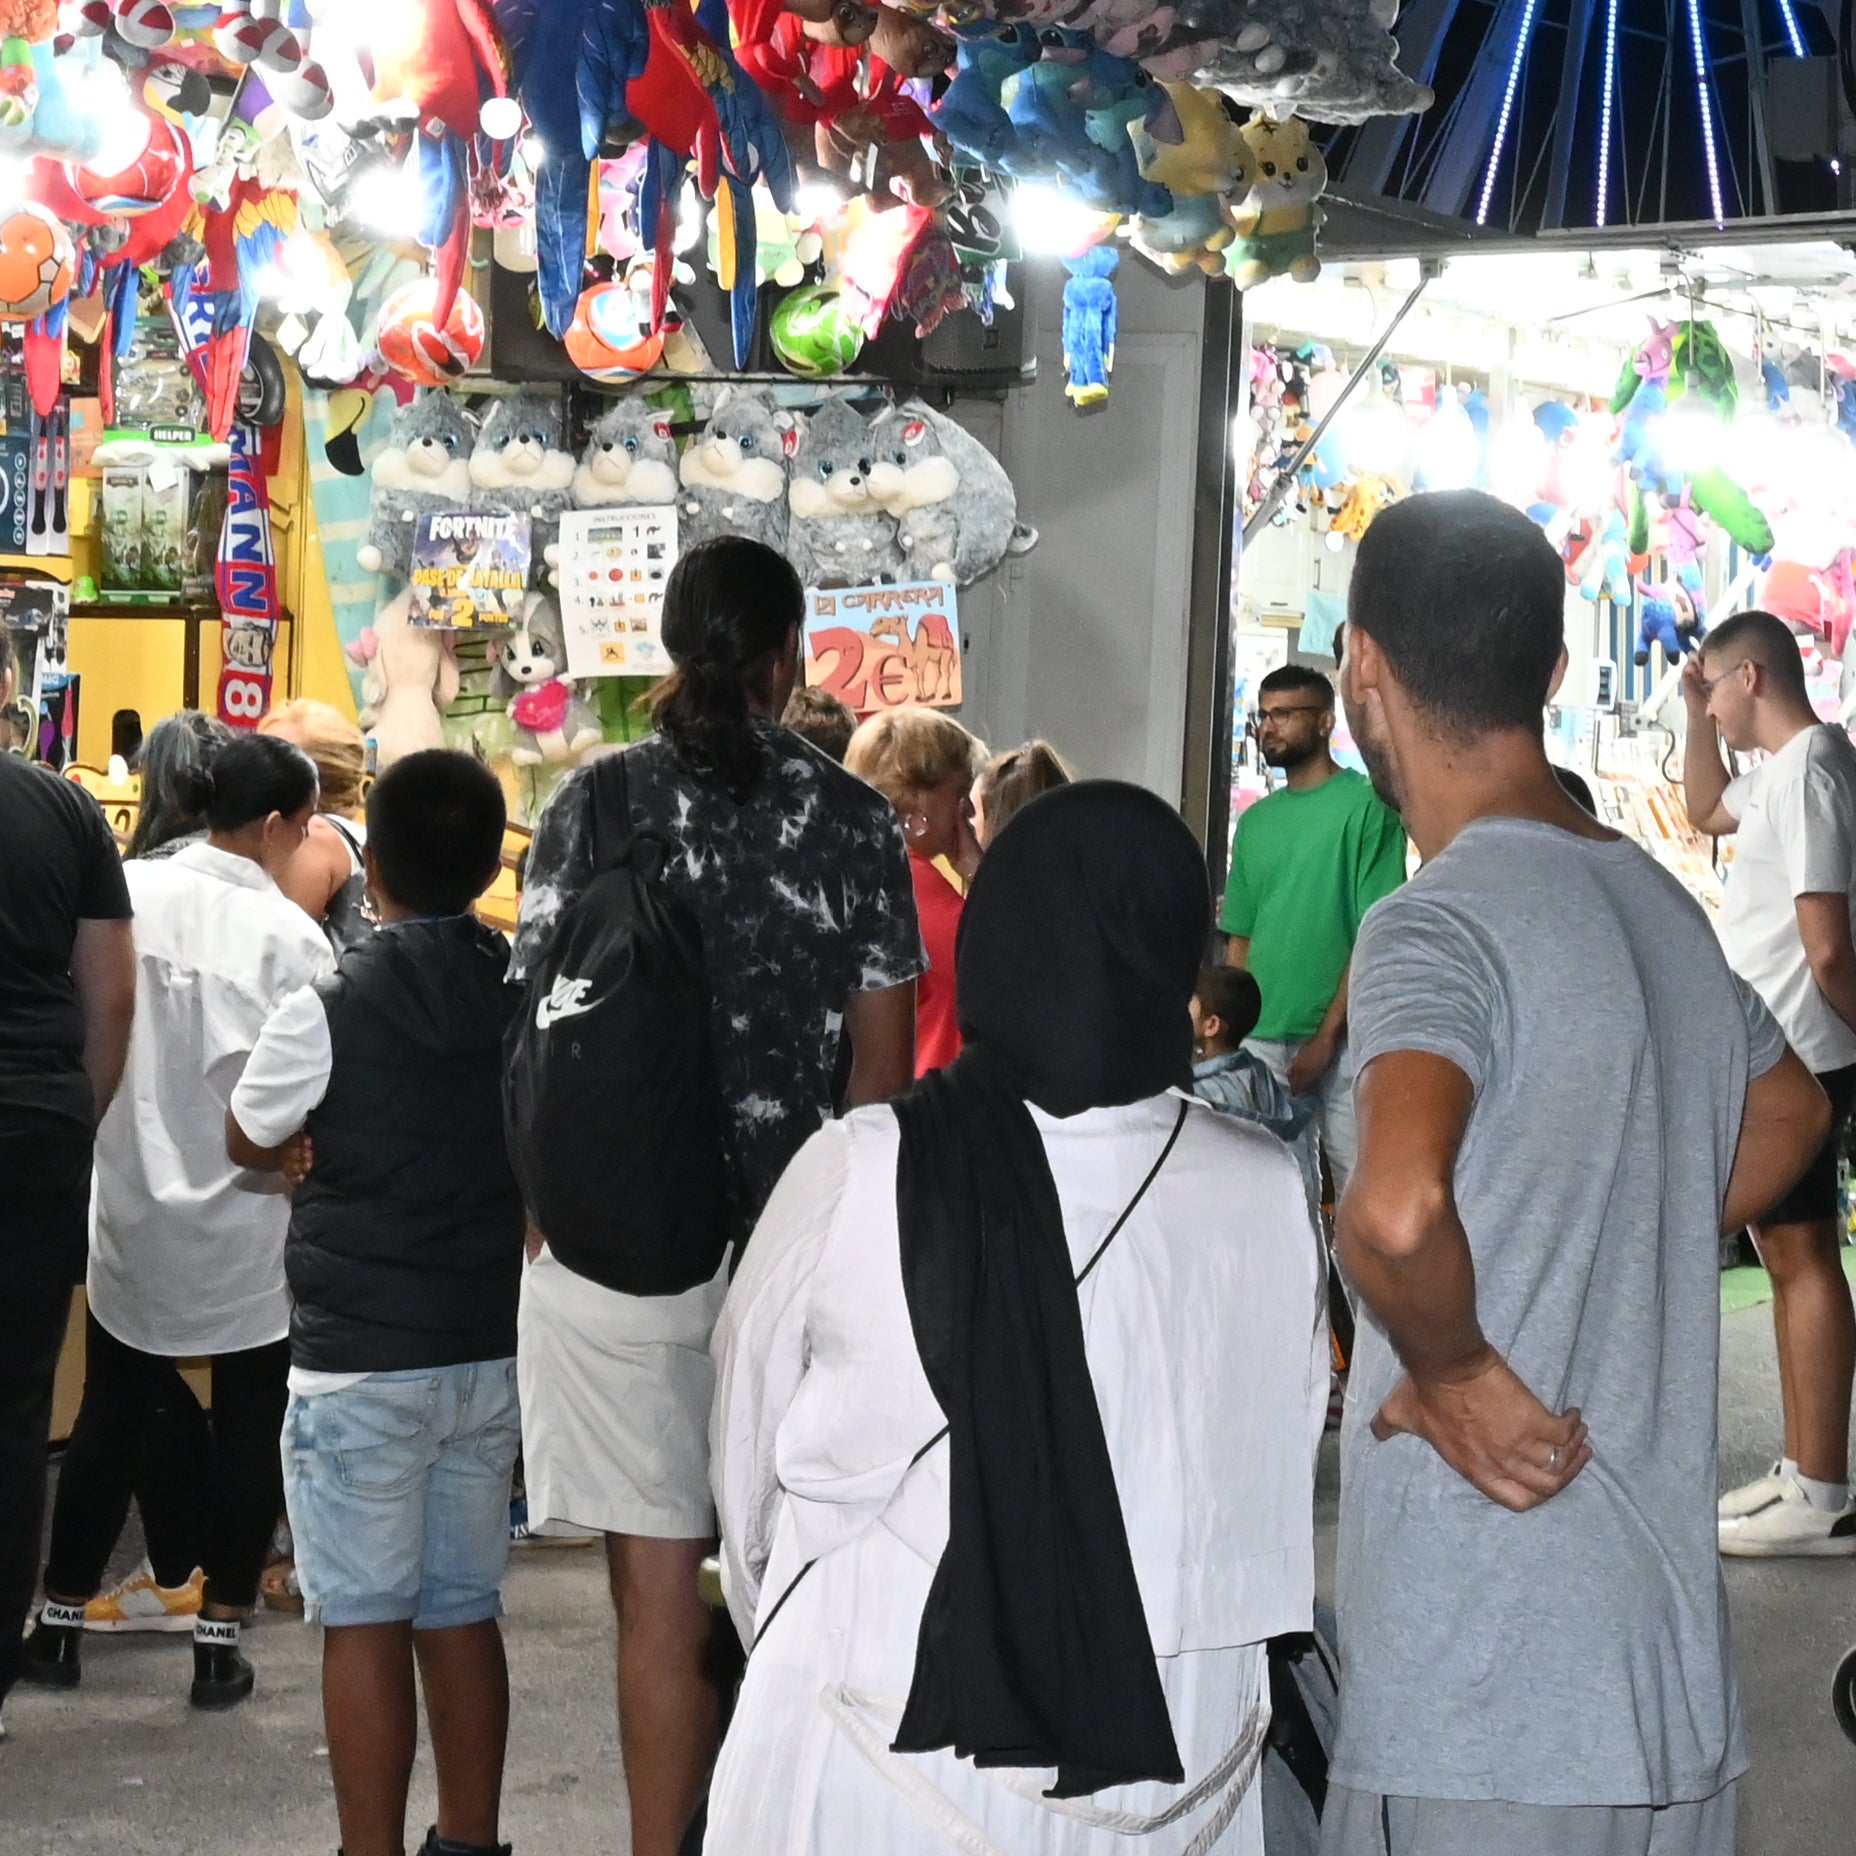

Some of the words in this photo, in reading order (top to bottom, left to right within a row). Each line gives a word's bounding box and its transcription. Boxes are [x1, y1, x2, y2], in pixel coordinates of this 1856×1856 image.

[153, 428, 194, 443] HELPER
[593, 513, 657, 523] INSTRUCCIONES
[842, 586, 943, 613] CARRERA
[450, 598, 475, 628] 2
[225, 676, 265, 719] 8
[195, 1624, 237, 1639] CHANEL
